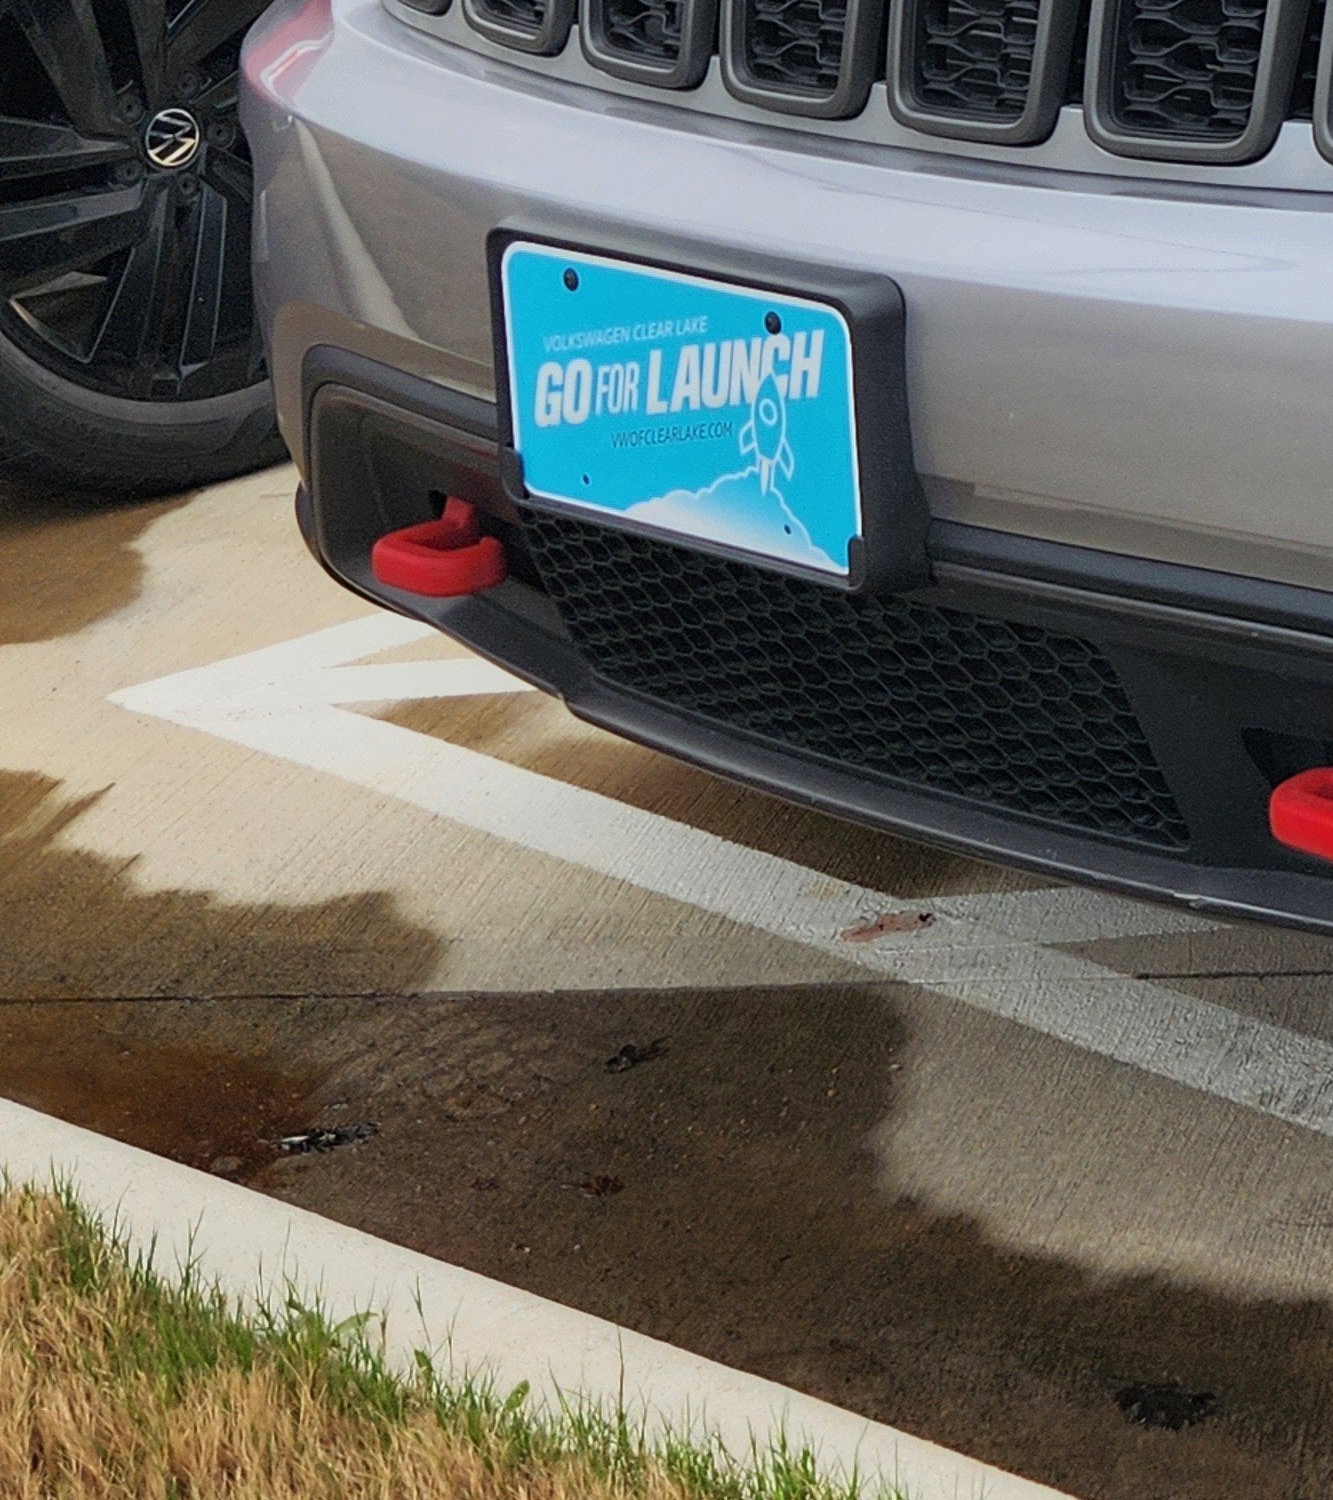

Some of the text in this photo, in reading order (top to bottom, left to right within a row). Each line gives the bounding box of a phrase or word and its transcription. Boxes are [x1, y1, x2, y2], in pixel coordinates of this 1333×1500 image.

[543, 315, 709, 354] VOLKSWAGEN CLEAR LAKE
[534, 329, 825, 428] GO FOR LAUNCH
[610, 420, 734, 450] VWOFCLEARLAKE.COM
